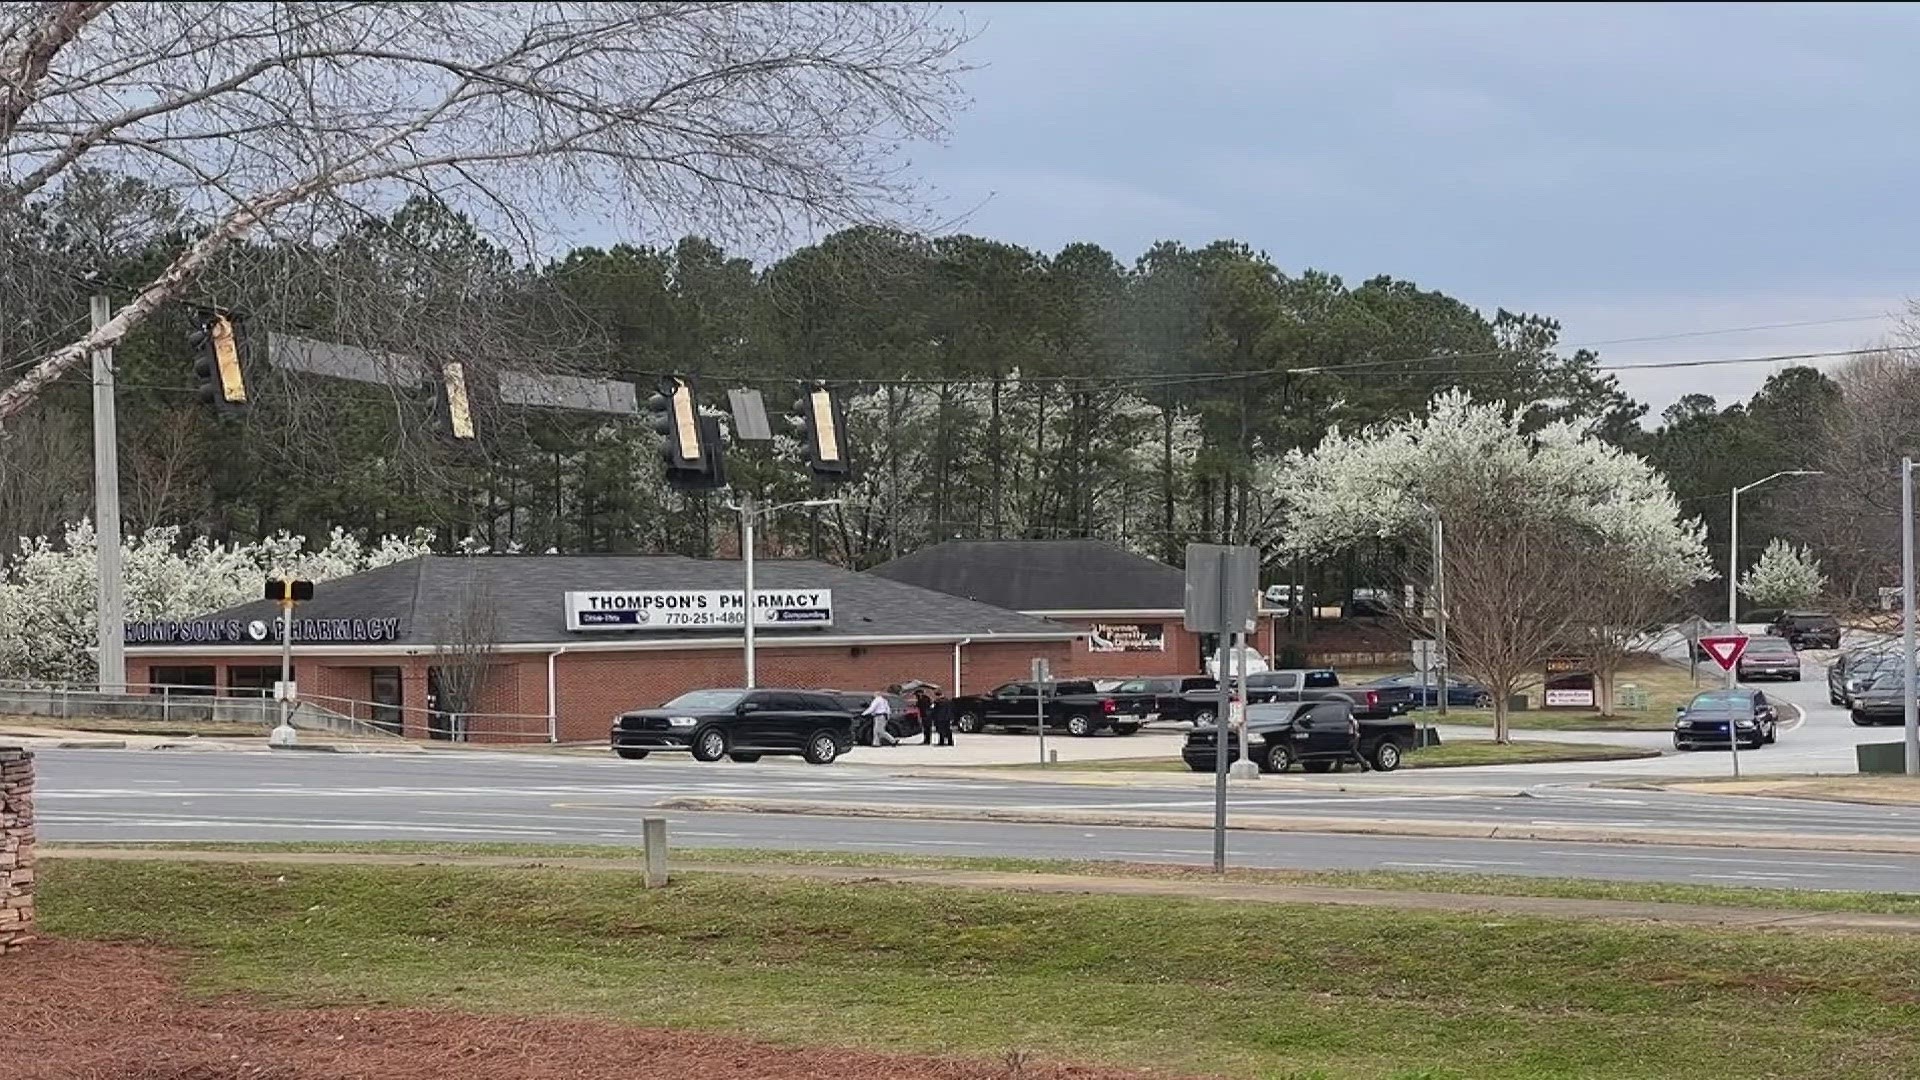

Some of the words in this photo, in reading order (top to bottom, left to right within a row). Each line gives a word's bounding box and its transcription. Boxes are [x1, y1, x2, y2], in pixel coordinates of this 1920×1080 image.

[588, 595, 707, 609] THOMPSON'S
[720, 594, 820, 608] PHRMACY
[665, 613, 744, 624] 770-251-480
[123, 620, 240, 641] HOMPSON'S
[273, 618, 397, 640] PHARMACY
